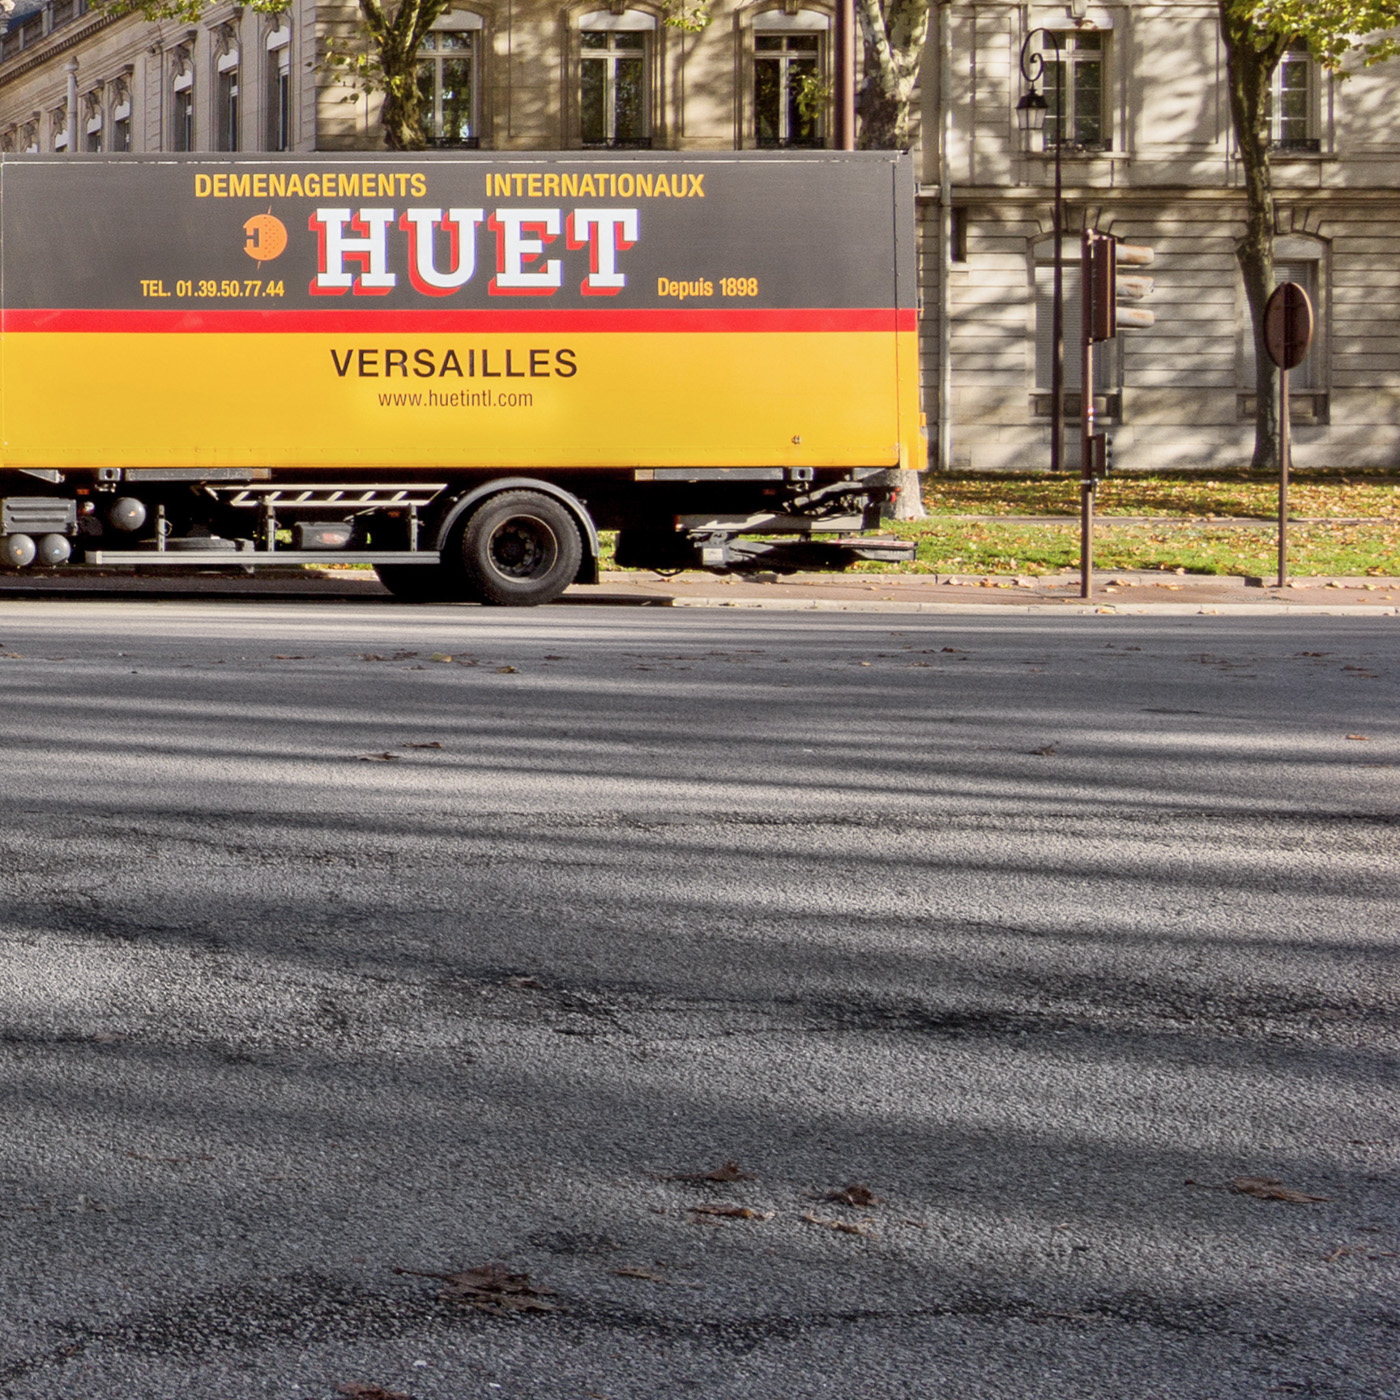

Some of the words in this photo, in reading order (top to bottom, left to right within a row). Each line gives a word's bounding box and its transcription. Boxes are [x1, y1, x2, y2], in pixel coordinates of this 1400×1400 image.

[194, 172, 427, 198] DEMENAGEMENTS
[485, 172, 705, 198] INTERNATIONAUX
[308, 207, 639, 297] HUET
[140, 280, 172, 298] TEL.
[175, 279, 286, 298] 01.39.50.77.44
[657, 276, 715, 301] Depuis
[719, 276, 760, 297] 1898
[329, 348, 578, 378] VERSAILLES
[378, 389, 534, 407] www.huetintl.com
